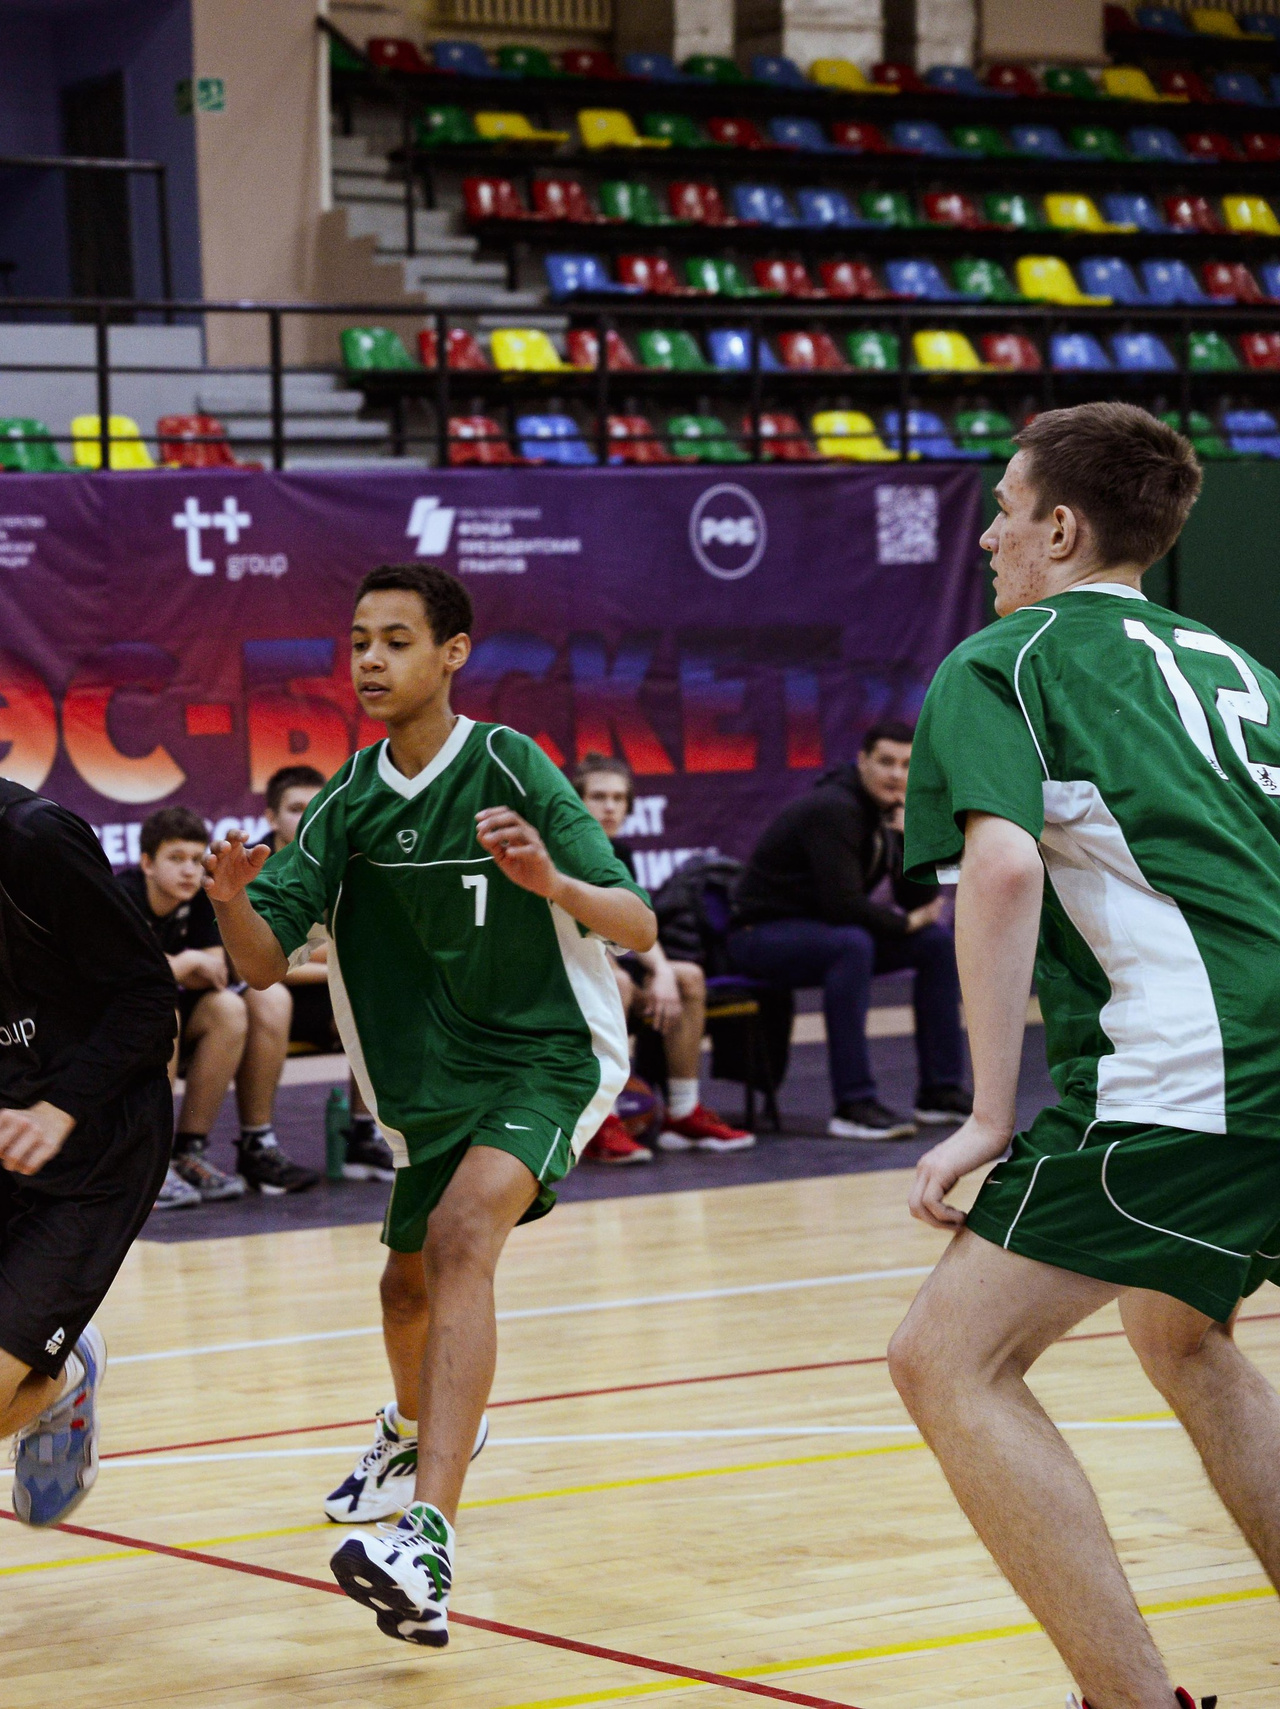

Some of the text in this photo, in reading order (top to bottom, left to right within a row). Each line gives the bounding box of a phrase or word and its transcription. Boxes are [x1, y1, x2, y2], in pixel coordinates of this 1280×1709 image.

[225, 552, 289, 581] group
[1122, 617, 1280, 798] 12
[460, 873, 489, 928] 7
